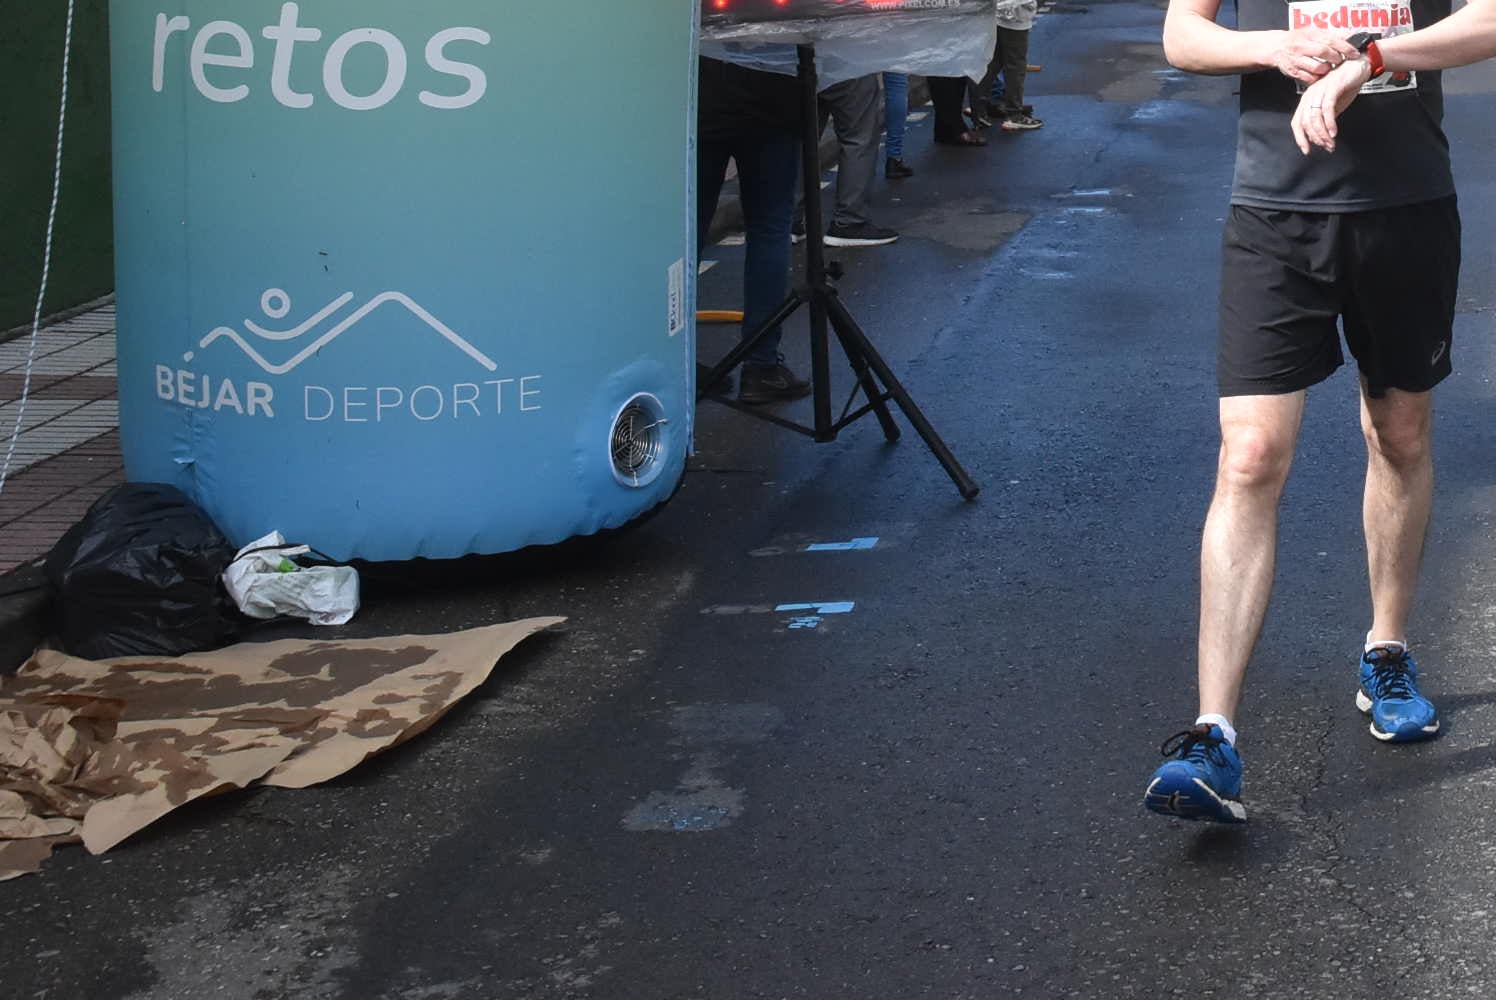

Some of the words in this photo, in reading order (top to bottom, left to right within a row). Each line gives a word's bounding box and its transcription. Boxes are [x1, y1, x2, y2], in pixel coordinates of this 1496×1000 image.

[1293, 3, 1411, 29] bedunia
[151, 2, 491, 110] retos
[304, 375, 542, 422] DEPORTE
